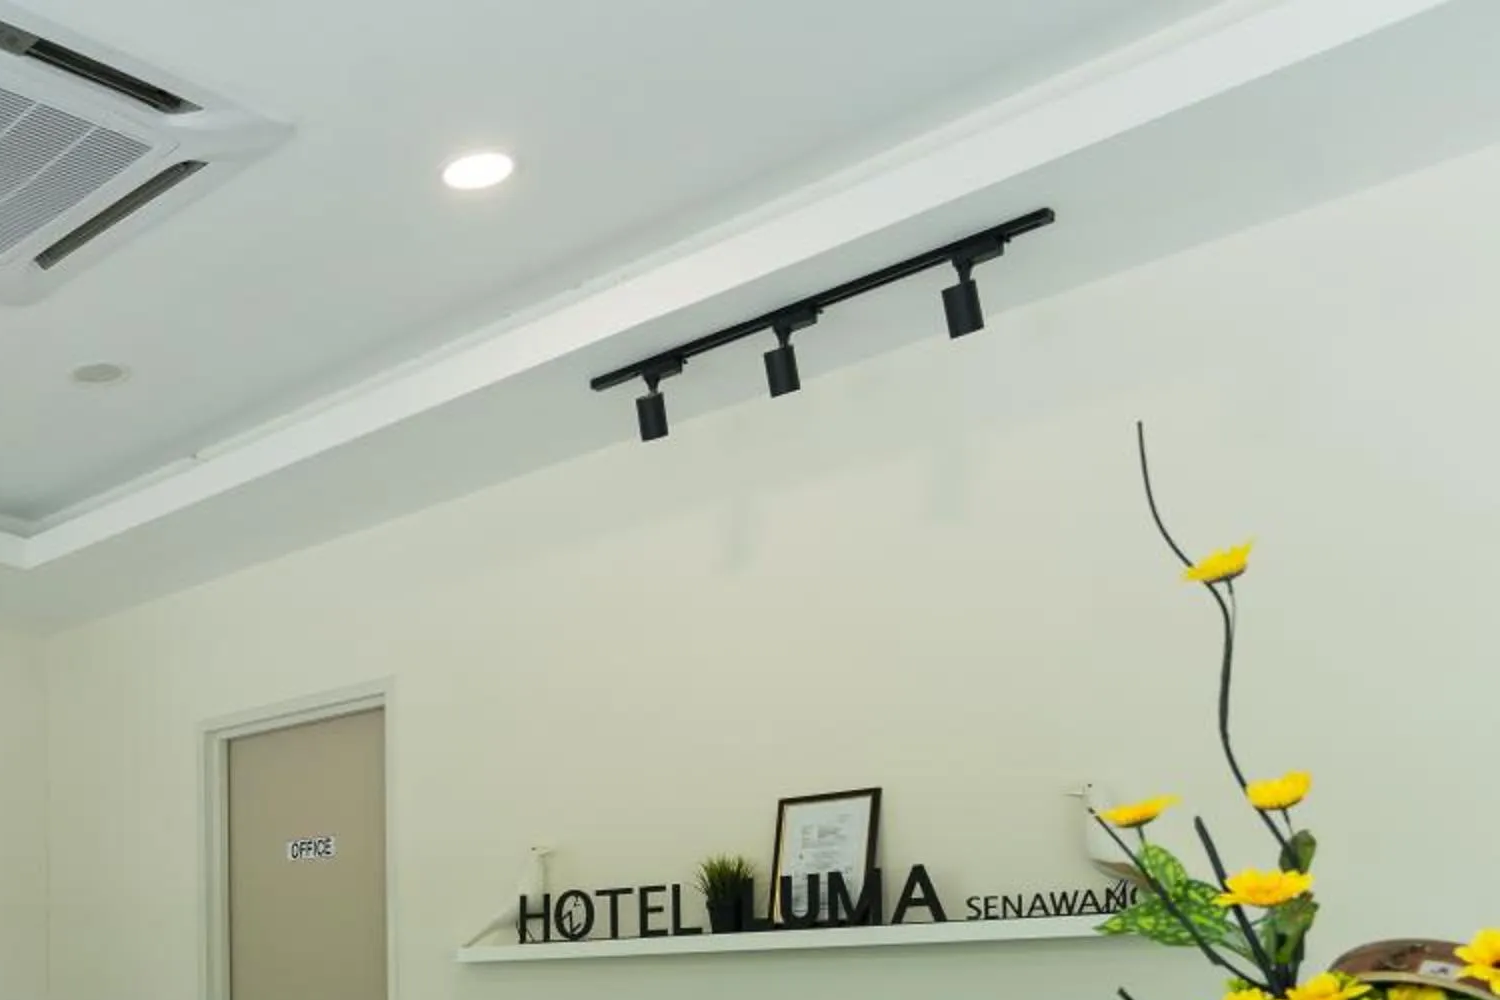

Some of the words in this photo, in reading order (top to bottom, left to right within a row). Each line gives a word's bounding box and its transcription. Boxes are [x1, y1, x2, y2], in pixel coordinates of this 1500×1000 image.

[291, 838, 332, 859] OFFICE
[518, 884, 704, 944] HOTEL
[740, 864, 948, 932] LUMA
